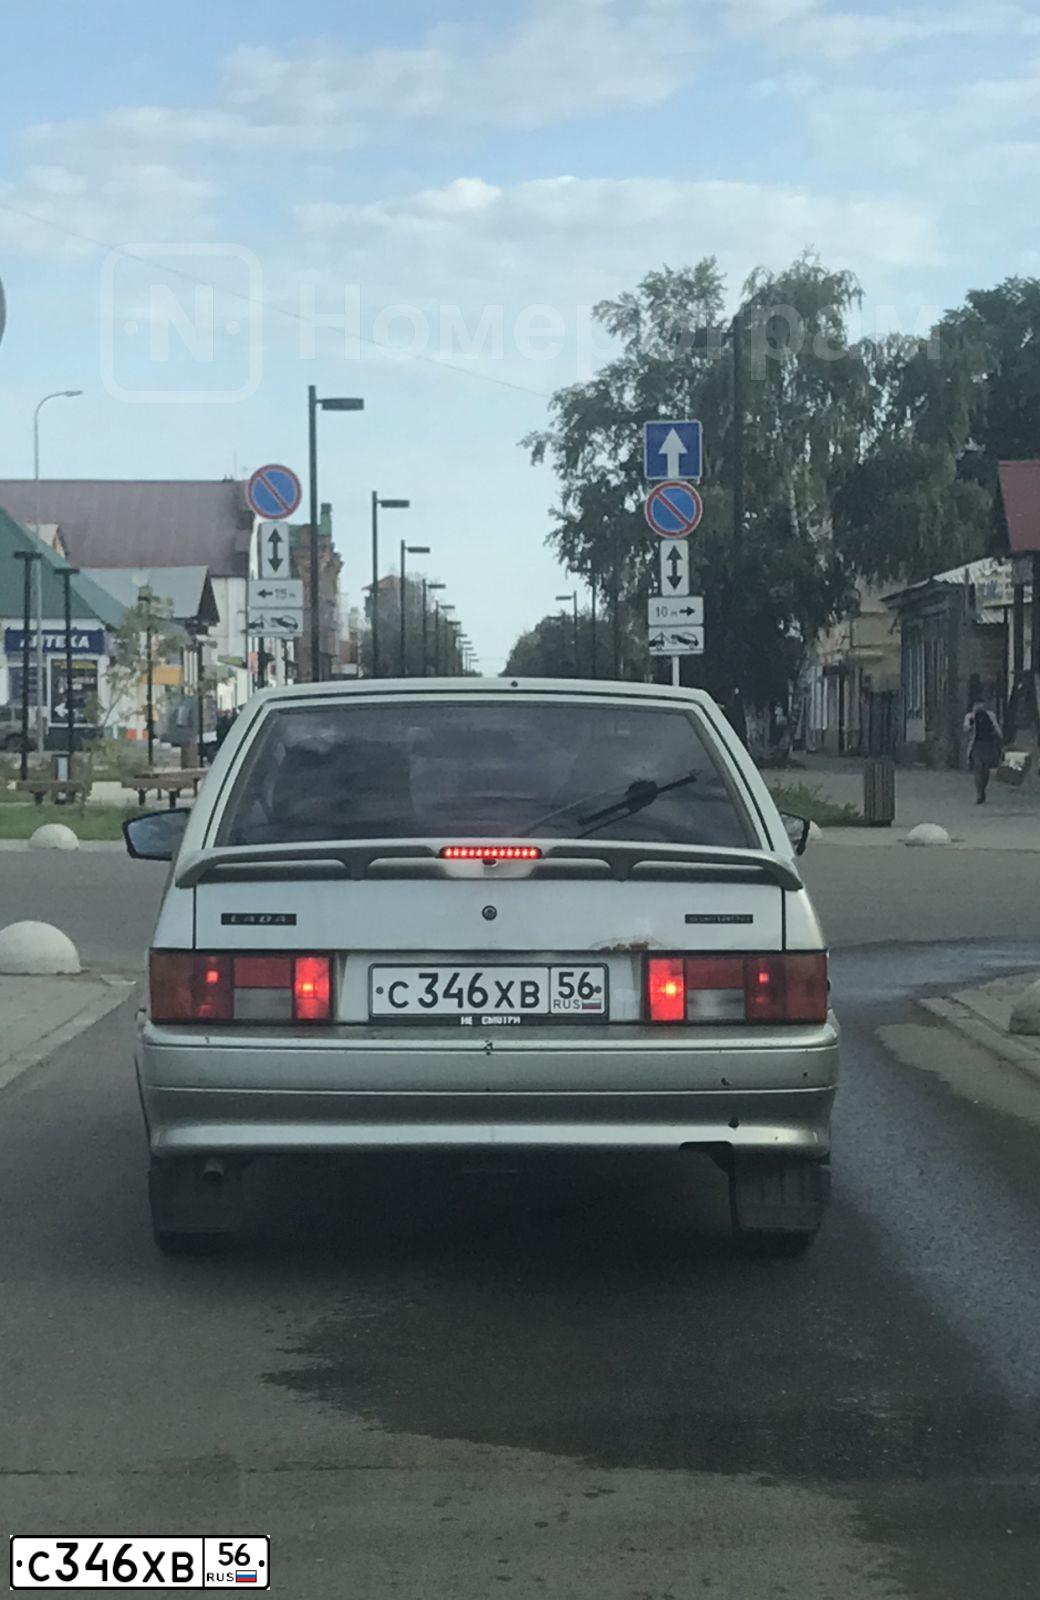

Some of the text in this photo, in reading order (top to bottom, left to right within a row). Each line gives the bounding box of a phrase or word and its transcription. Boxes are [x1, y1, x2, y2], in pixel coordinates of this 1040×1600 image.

[274, 588, 288, 600] 15
[656, 605, 668, 618] 10
[388, 971, 594, 1009] С346ХВ 56
[553, 999, 580, 1009] RUS
